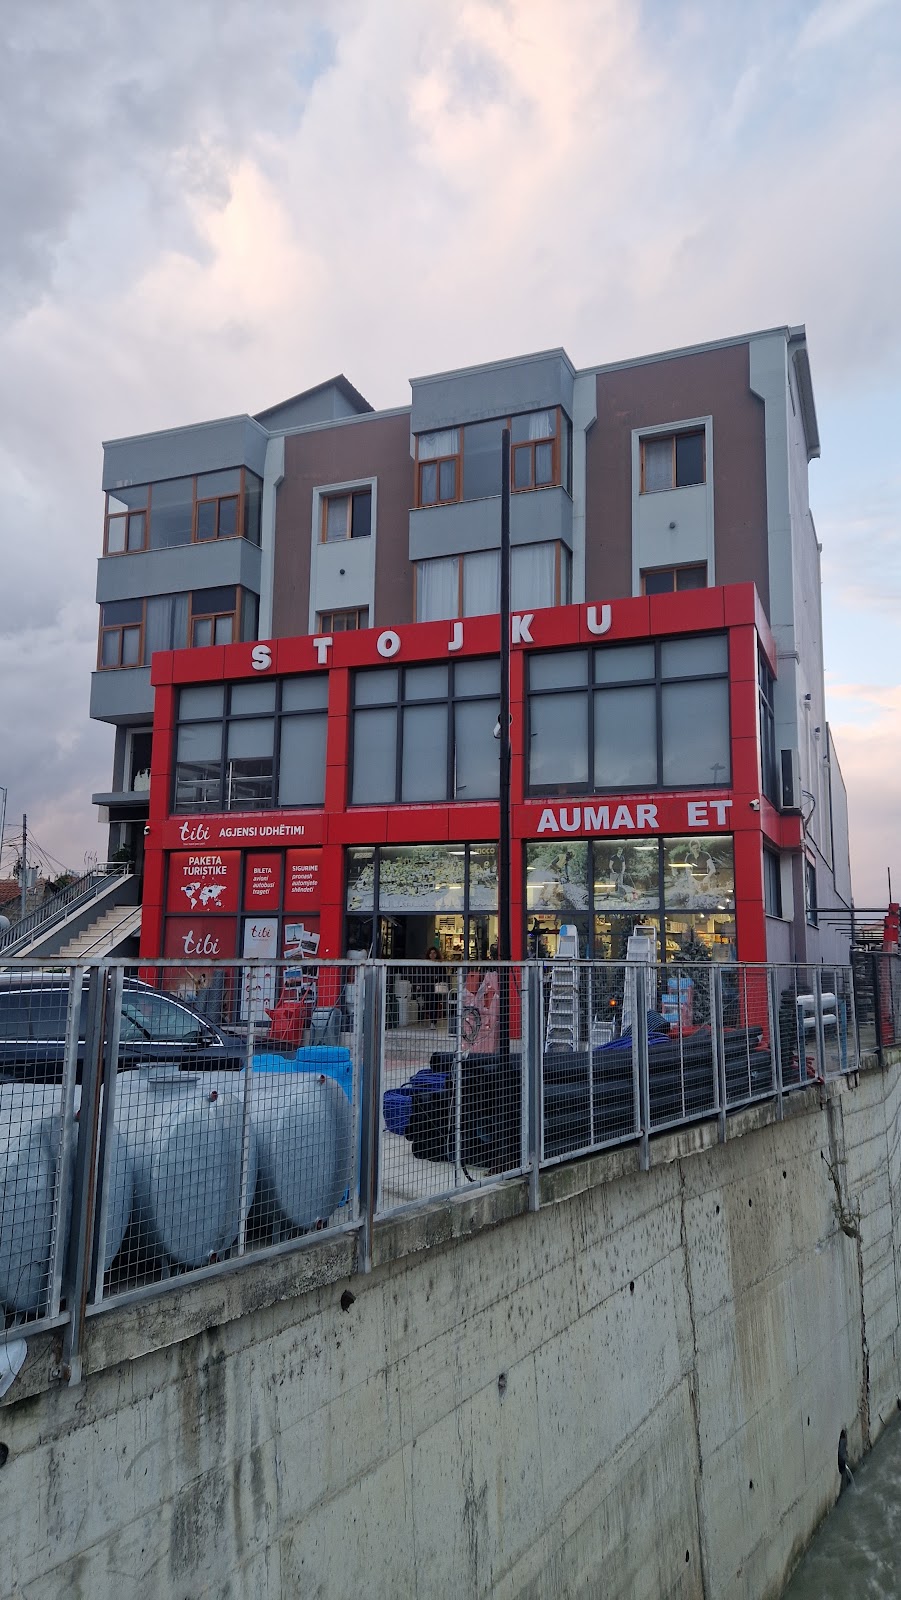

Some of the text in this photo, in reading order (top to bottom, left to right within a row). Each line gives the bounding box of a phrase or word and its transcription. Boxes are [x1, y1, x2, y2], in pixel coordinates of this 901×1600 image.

[251, 604, 613, 671] STOJKU
[537, 800, 733, 833] AUMAR ET
[179, 821, 305, 841] tibi AGJENSI UDHËTIMI
[183, 865, 228, 876] TURISTIKE
[188, 856, 222, 866] PAKETA
[251, 925, 271, 938] tibi
[181, 930, 221, 955] tibi
